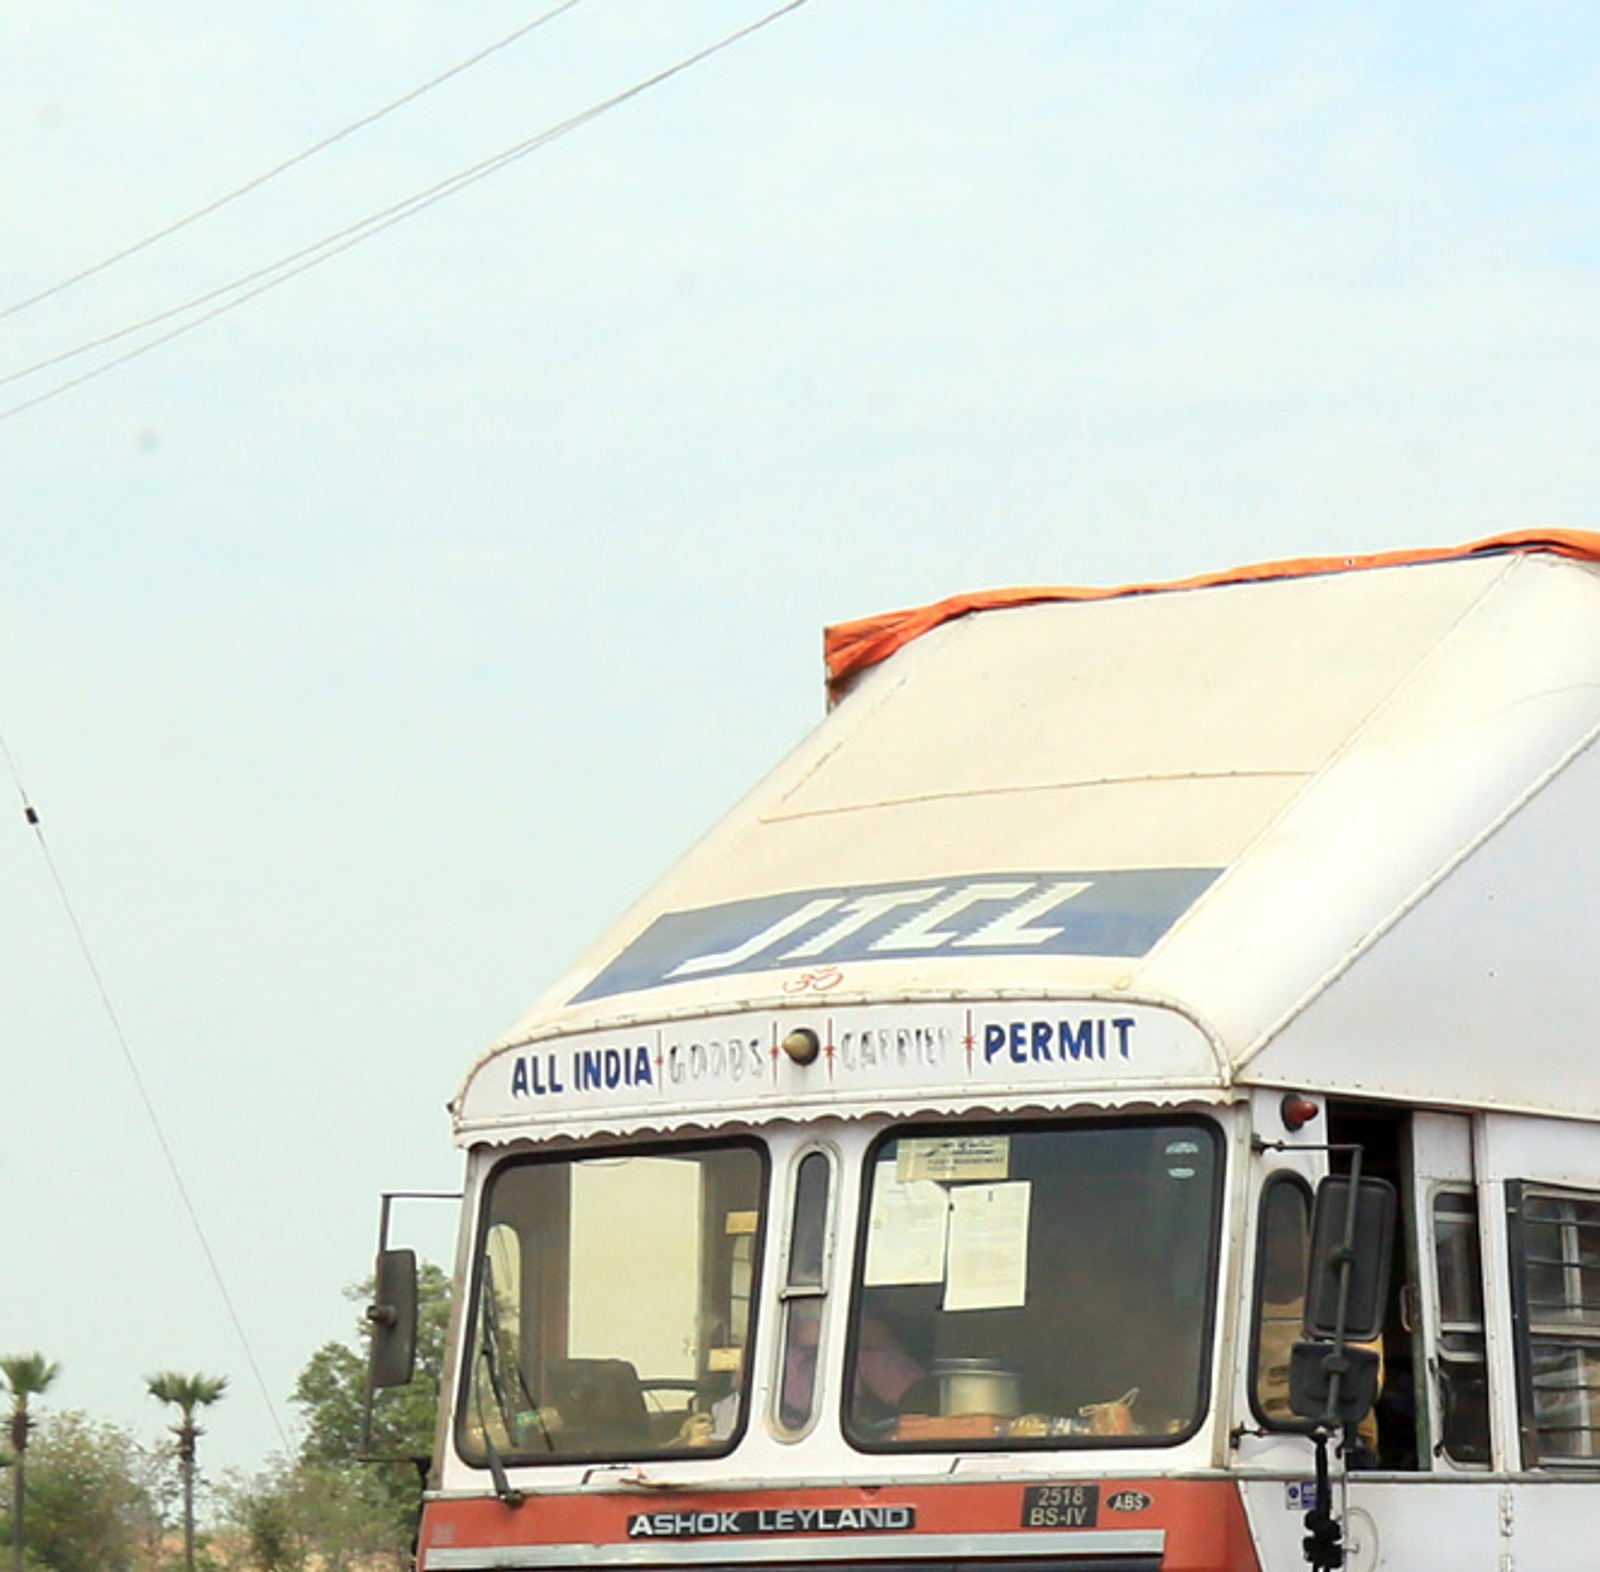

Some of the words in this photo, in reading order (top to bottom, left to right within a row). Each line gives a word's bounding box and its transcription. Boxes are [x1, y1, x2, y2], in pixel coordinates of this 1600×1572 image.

[512, 1056, 563, 1097] ALL
[574, 1047, 653, 1091] INDIA
[983, 1018, 1137, 1065] PERMIT
[1038, 1486, 1084, 1507] 2518
[1113, 1493, 1144, 1511] ABS
[630, 1513, 740, 1535] ASHOK
[758, 1507, 908, 1531] LEYLAND
[1030, 1507, 1087, 1526] BS-IV
